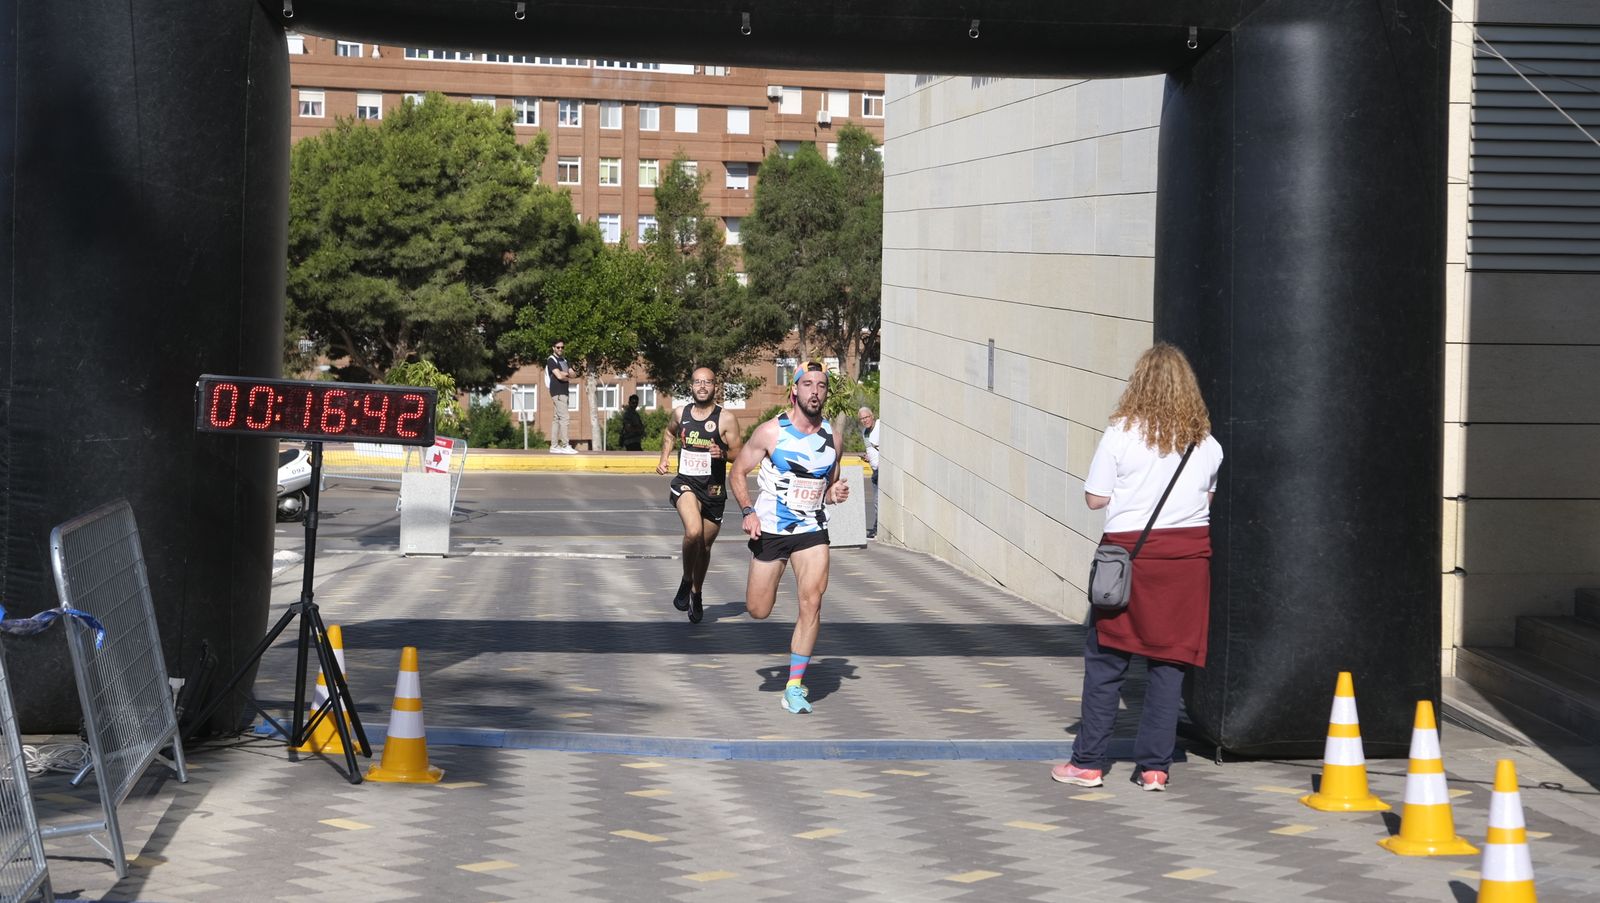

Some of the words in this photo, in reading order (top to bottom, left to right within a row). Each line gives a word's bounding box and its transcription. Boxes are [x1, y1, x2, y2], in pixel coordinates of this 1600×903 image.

[210, 383, 425, 438] 00:16:42
[683, 458, 708, 468] 1076
[291, 466, 305, 475] 092
